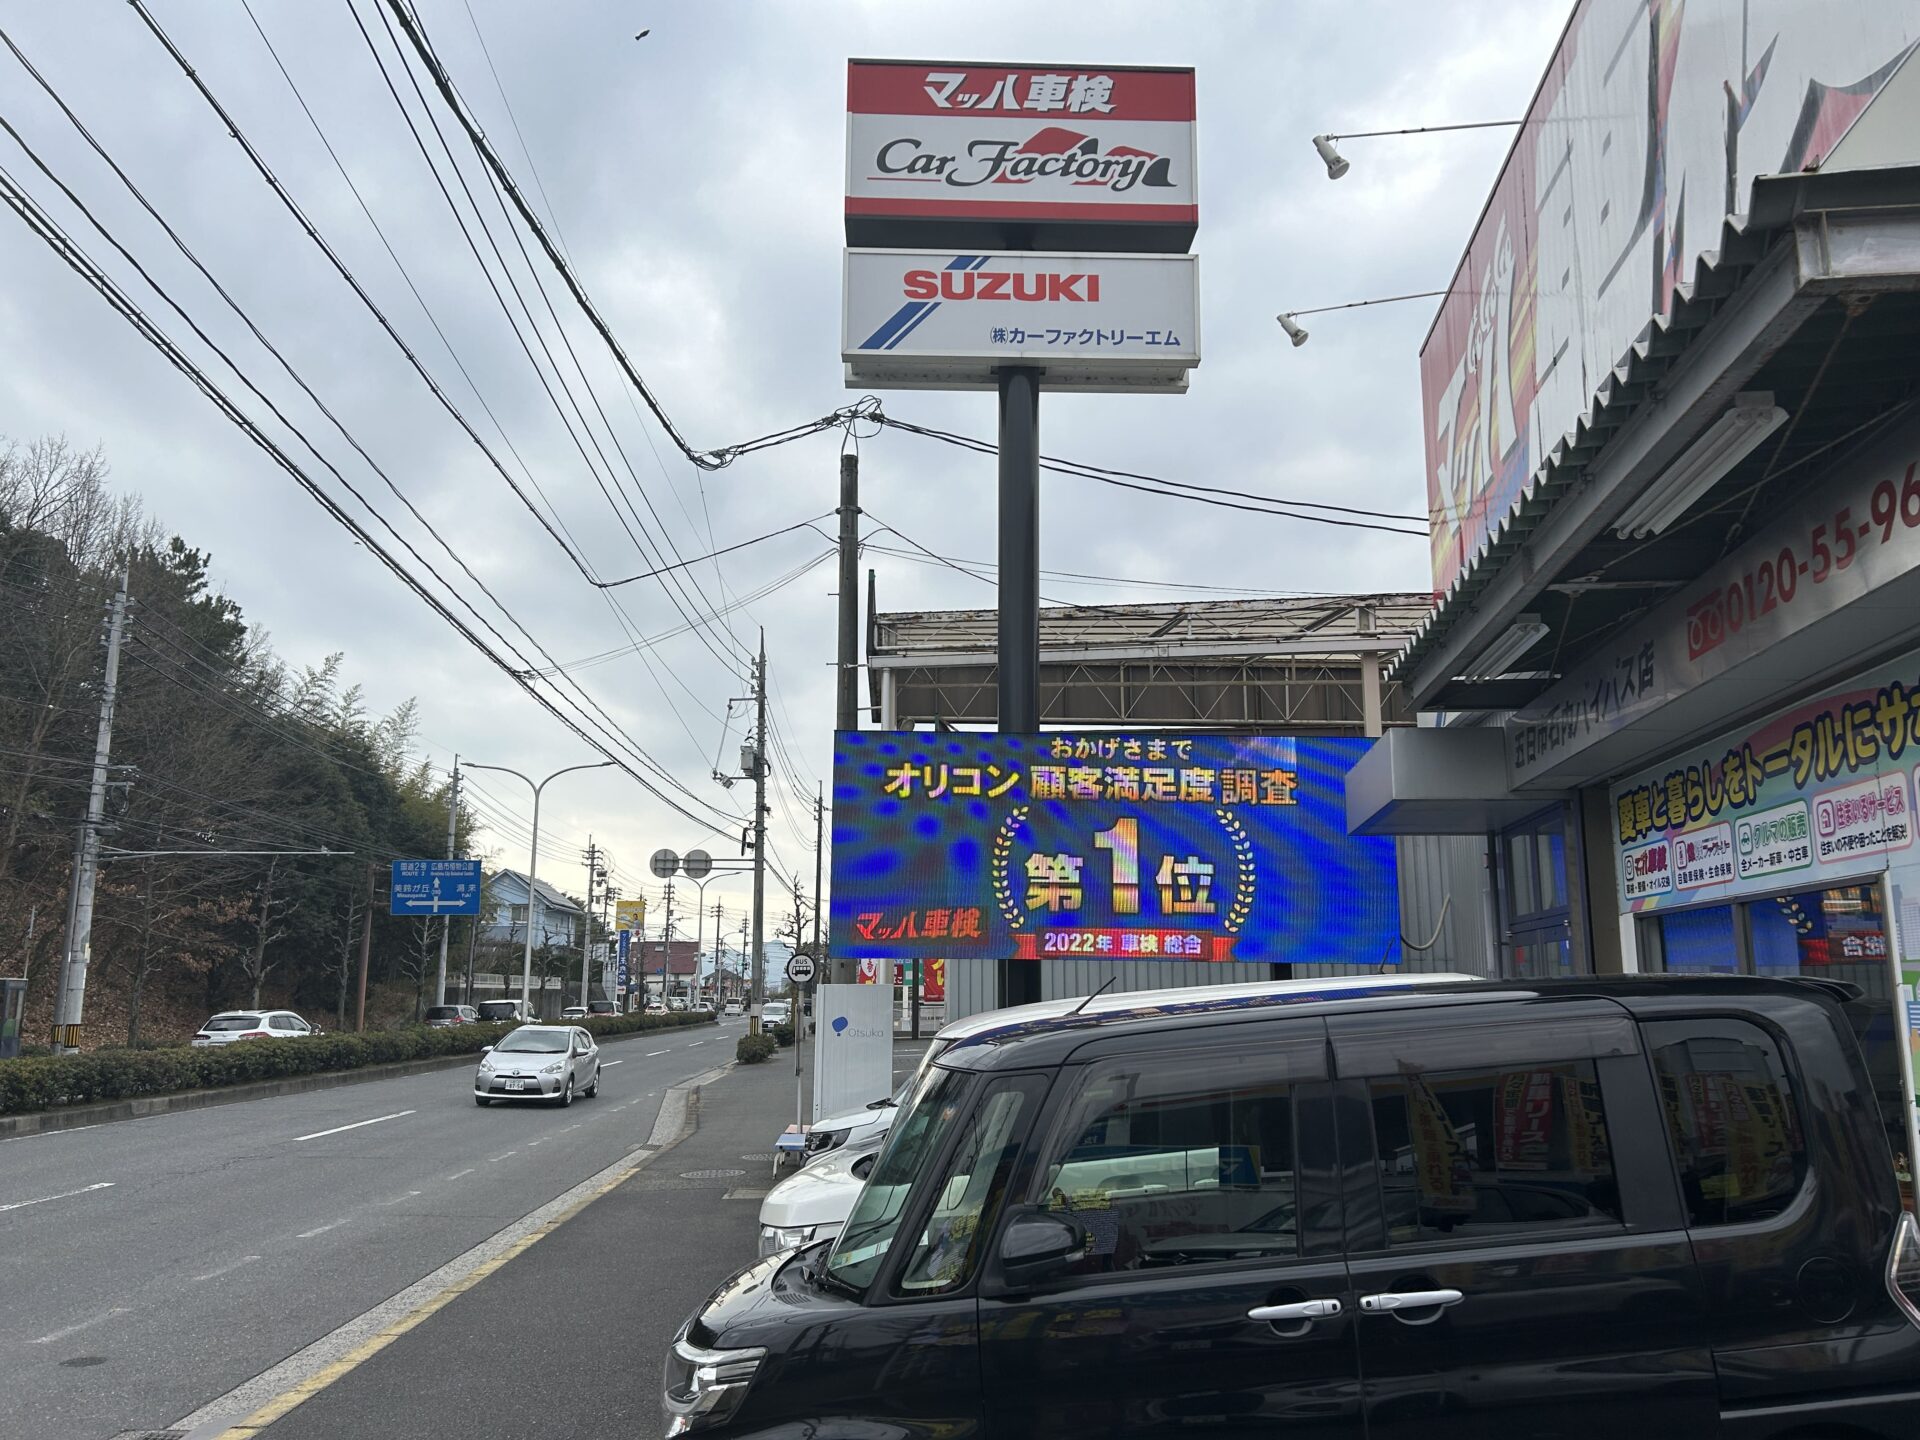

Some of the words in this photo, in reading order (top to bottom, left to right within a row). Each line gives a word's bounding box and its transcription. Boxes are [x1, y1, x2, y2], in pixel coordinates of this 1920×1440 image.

[923, 72, 1117, 114] マッハ車検
[876, 138, 955, 176] Car
[946, 138, 1147, 192] Factory
[903, 270, 1100, 302] SUZUKI
[1050, 736, 1193, 761] おかげさまで
[884, 762, 1020, 798] オリコン
[1753, 811, 1808, 848] クルマの販売
[1024, 817, 1216, 914] 第1位
[855, 907, 983, 940] マッハ車検
[1044, 932, 1113, 953] 2022年
[1121, 932, 1158, 953] 車検
[1164, 933, 1202, 954] 総合
[848, 1027, 885, 1039] Otsuka
